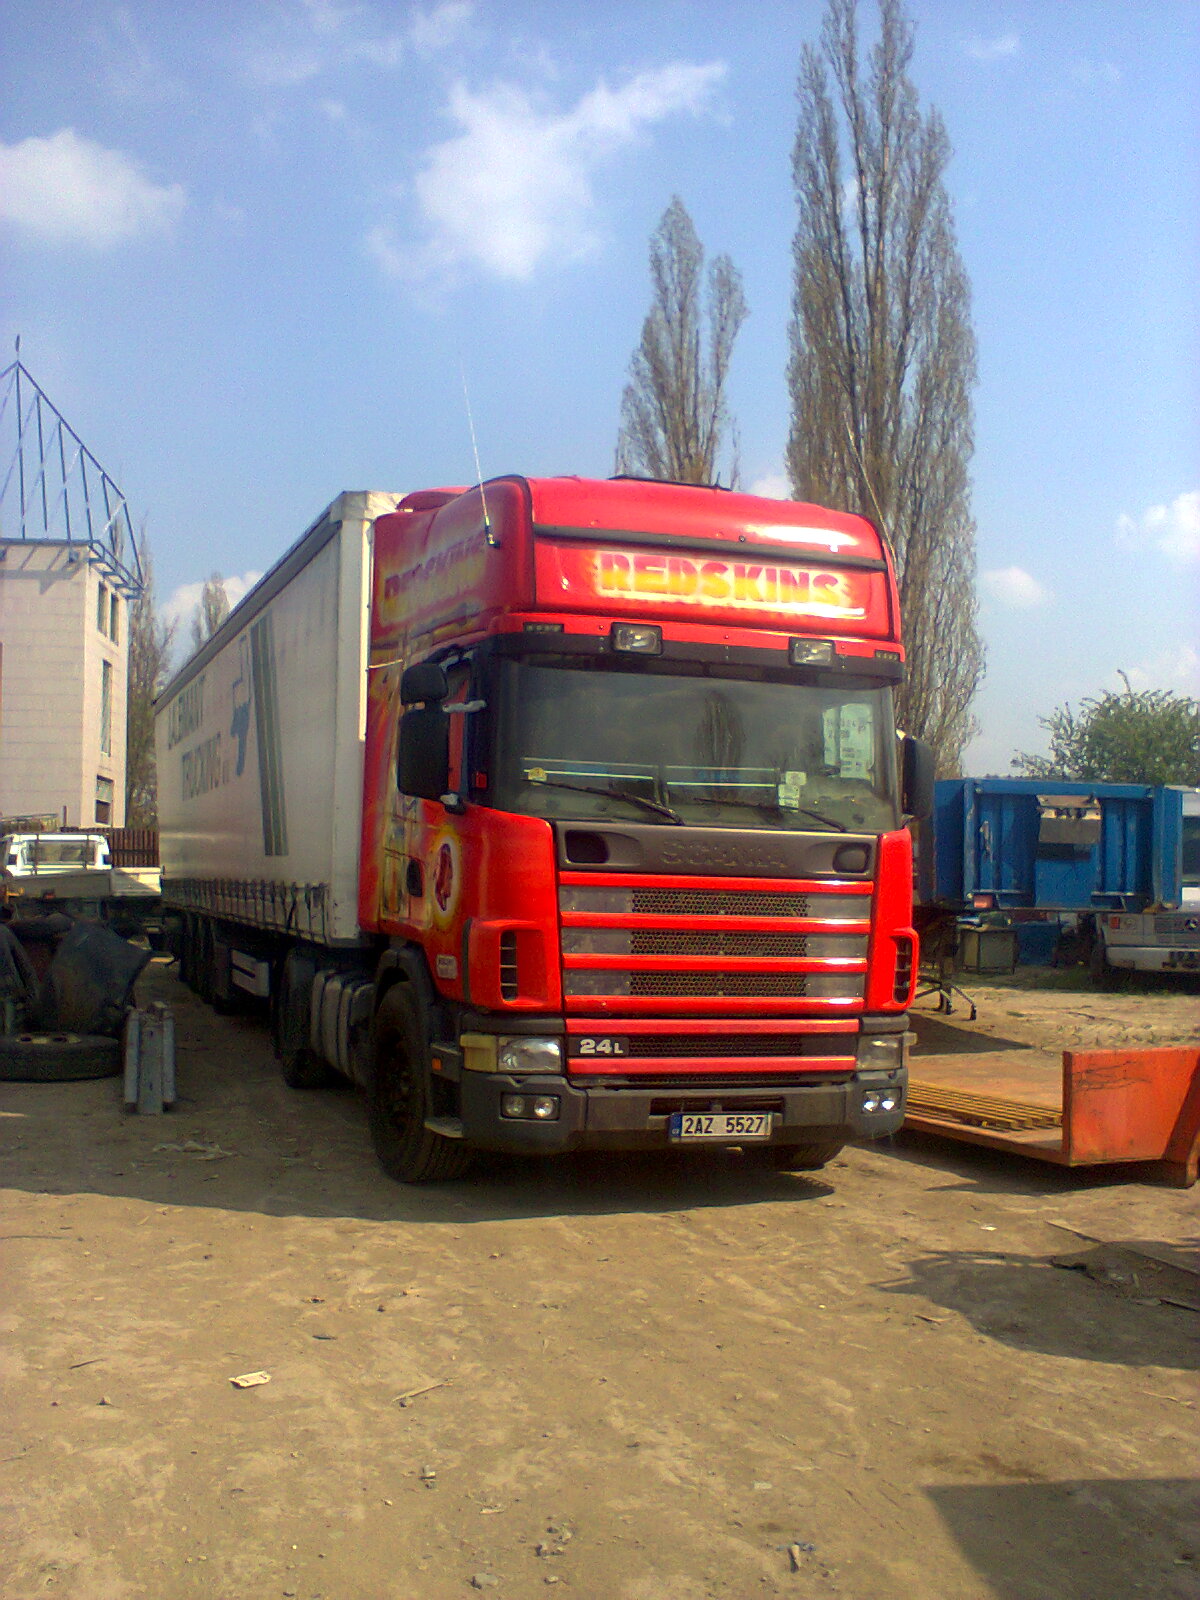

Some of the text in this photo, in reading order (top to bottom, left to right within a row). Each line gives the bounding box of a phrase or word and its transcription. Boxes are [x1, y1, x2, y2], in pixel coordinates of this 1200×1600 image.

[599, 552, 841, 606] REDSKINS
[684, 1116, 765, 1134] 2AZ 5527
